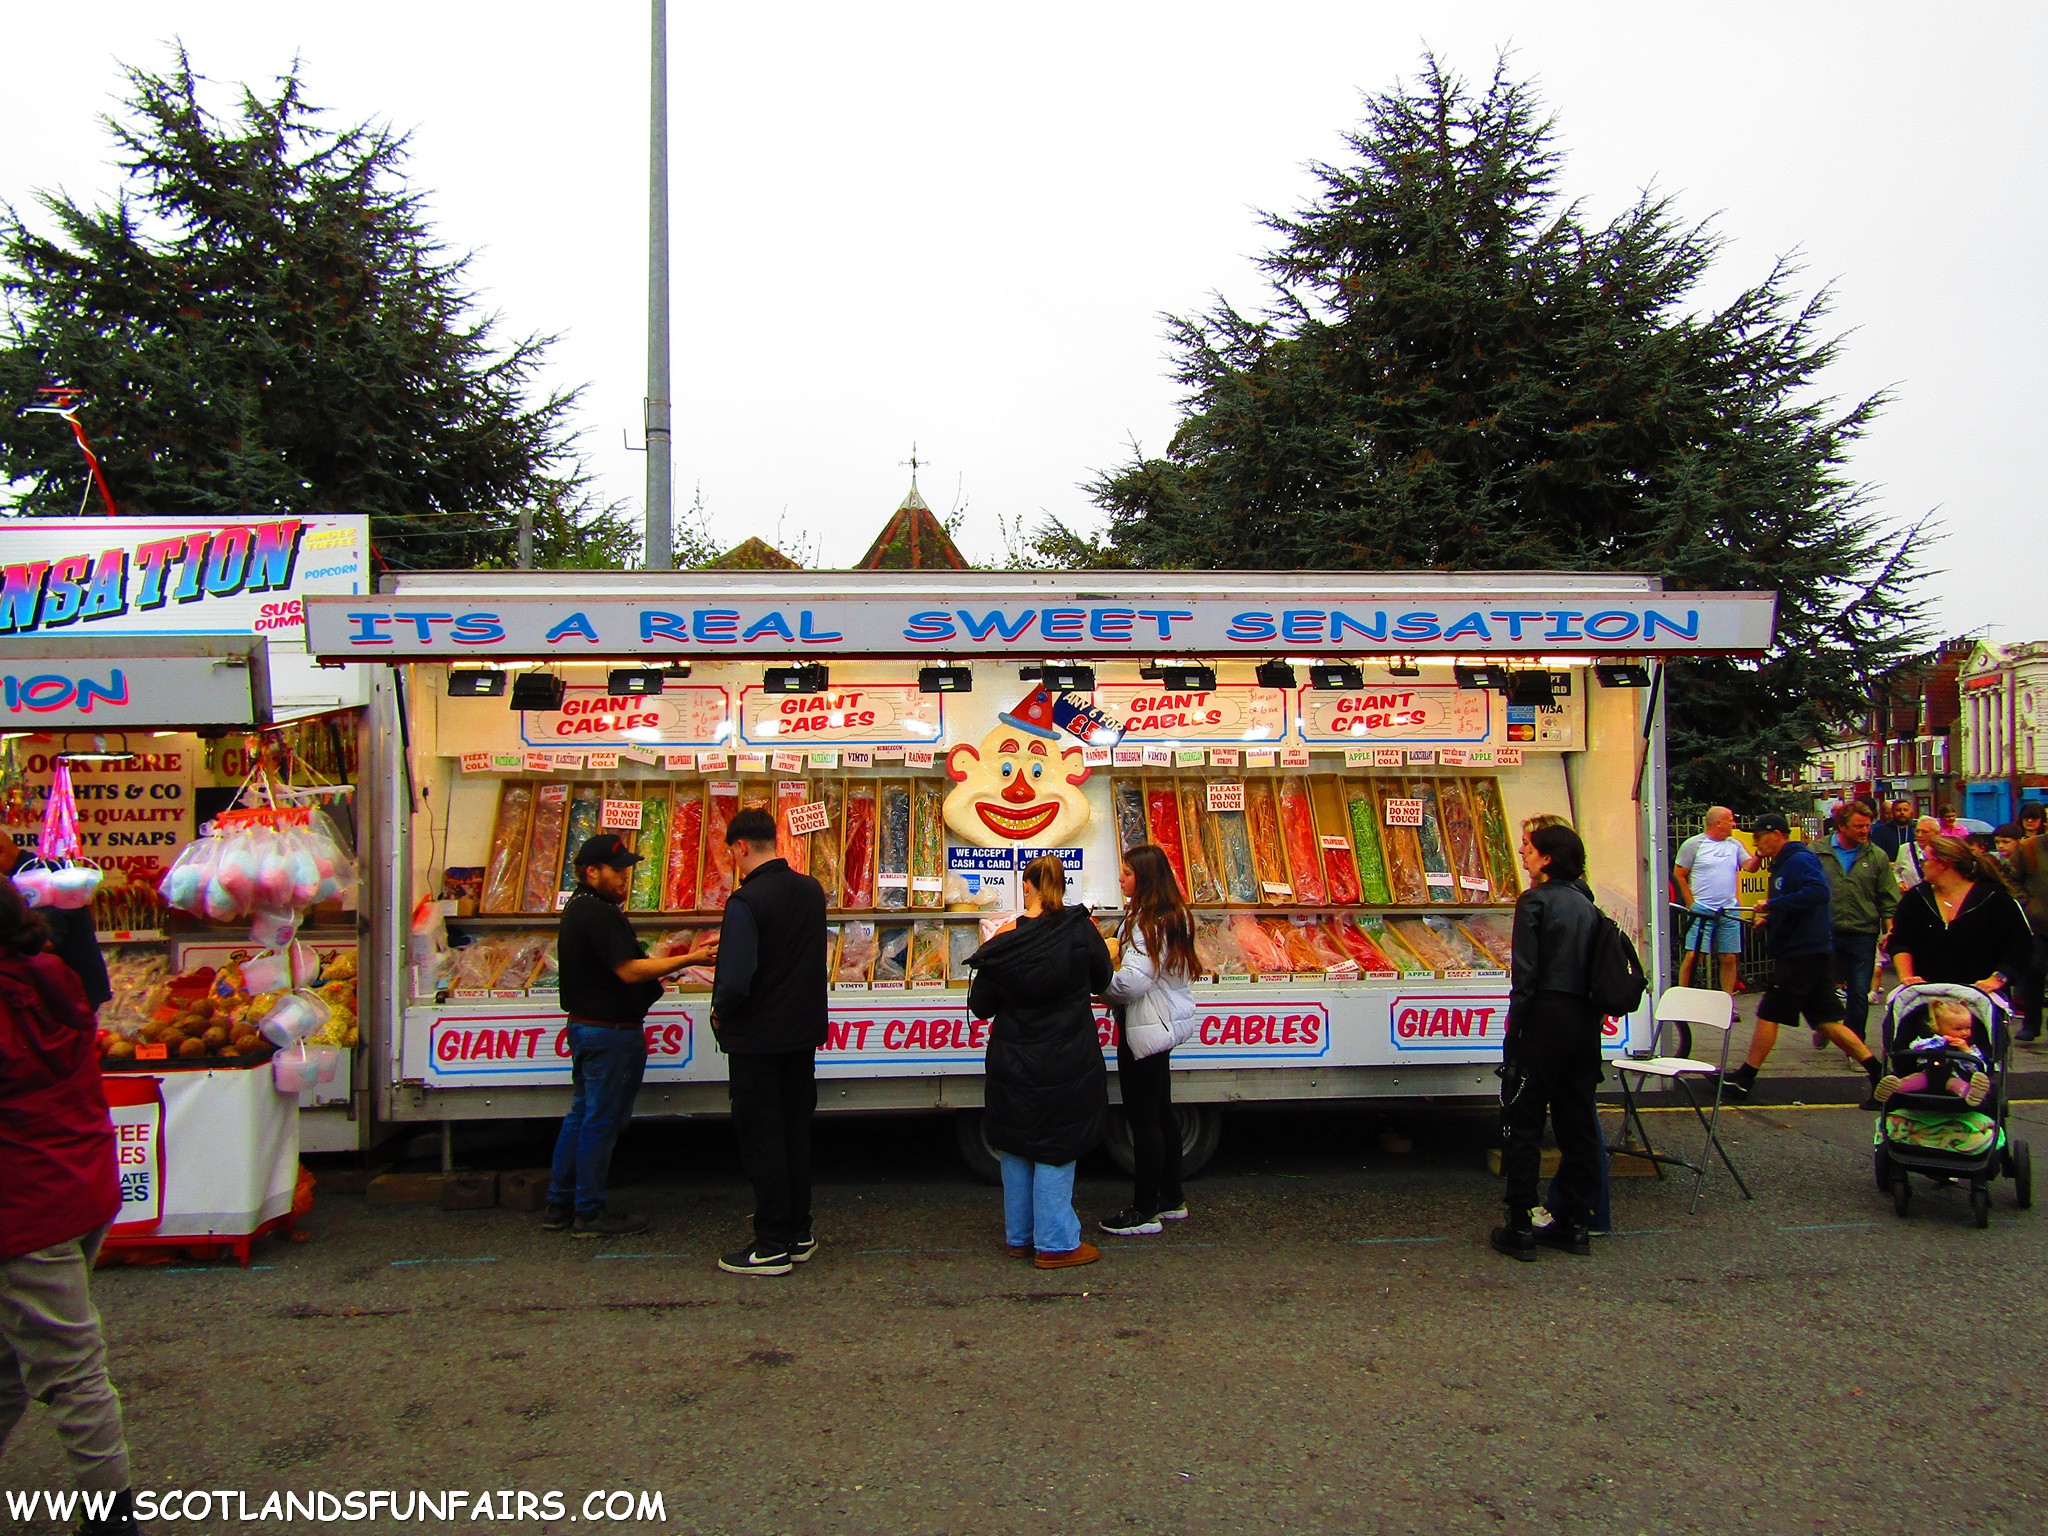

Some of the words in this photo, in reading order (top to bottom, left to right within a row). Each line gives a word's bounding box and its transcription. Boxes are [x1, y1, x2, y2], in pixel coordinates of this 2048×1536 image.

[0, 518, 305, 633] NSATION
[305, 564, 357, 579] POPCORN
[260, 600, 303, 617] SUG
[347, 612, 506, 645] ITS
[545, 611, 599, 643] A
[639, 609, 844, 644] REAL
[902, 608, 1193, 643] SWEET
[1226, 609, 1699, 643] SENSATION
[0, 668, 128, 713] ION
[1551, 685, 1567, 693] RD
[562, 694, 648, 715] GIANT
[780, 692, 864, 714] GIANT
[1130, 692, 1211, 712] GIANT
[1337, 692, 1414, 713] GIANT
[1063, 692, 1091, 711] ANY
[1088, 708, 1100, 719] 6
[1098, 713, 1124, 734] FOR
[1540, 705, 1563, 714] VISA
[631, 745, 656, 755] APPLE
[1085, 750, 1108, 760] RAINBOW
[1115, 752, 1141, 761] BUBBLEGUM
[1147, 751, 1167, 761] VIMTO
[1349, 752, 1371, 761] APPLE
[100, 754, 182, 773] HERE
[463, 753, 489, 761] FIZZY
[847, 753, 868, 762] VIMTO
[908, 752, 932, 763] RAINBOW
[465, 762, 489, 770] COLA
[125, 784, 144, 799] &
[150, 784, 181, 799] CO
[1224, 793, 1242, 801] NOT
[606, 801, 640, 810] PLEASE
[790, 802, 824, 815] PLEASE
[1403, 807, 1420, 815] NOT
[94, 809, 185, 825] QUALITY
[606, 809, 618, 817] DO
[791, 815, 805, 825] DO
[806, 811, 825, 821] NOT
[606, 818, 638, 827] TOUCH
[794, 819, 826, 832] TOUCH
[108, 832, 176, 846] SNAPS
[956, 849, 970, 857] WE
[972, 849, 1007, 858] ACCEPT
[1025, 850, 1039, 859] WE
[951, 859, 975, 868] CASH
[978, 860, 985, 868] &
[987, 860, 1011, 869] CARD
[983, 876, 1005, 885] VISA
[1742, 877, 1765, 893] HULL
[1397, 1007, 1495, 1038] GIANT
[1199, 1013, 1320, 1046] CABLES
[437, 1027, 546, 1061] GIANT
